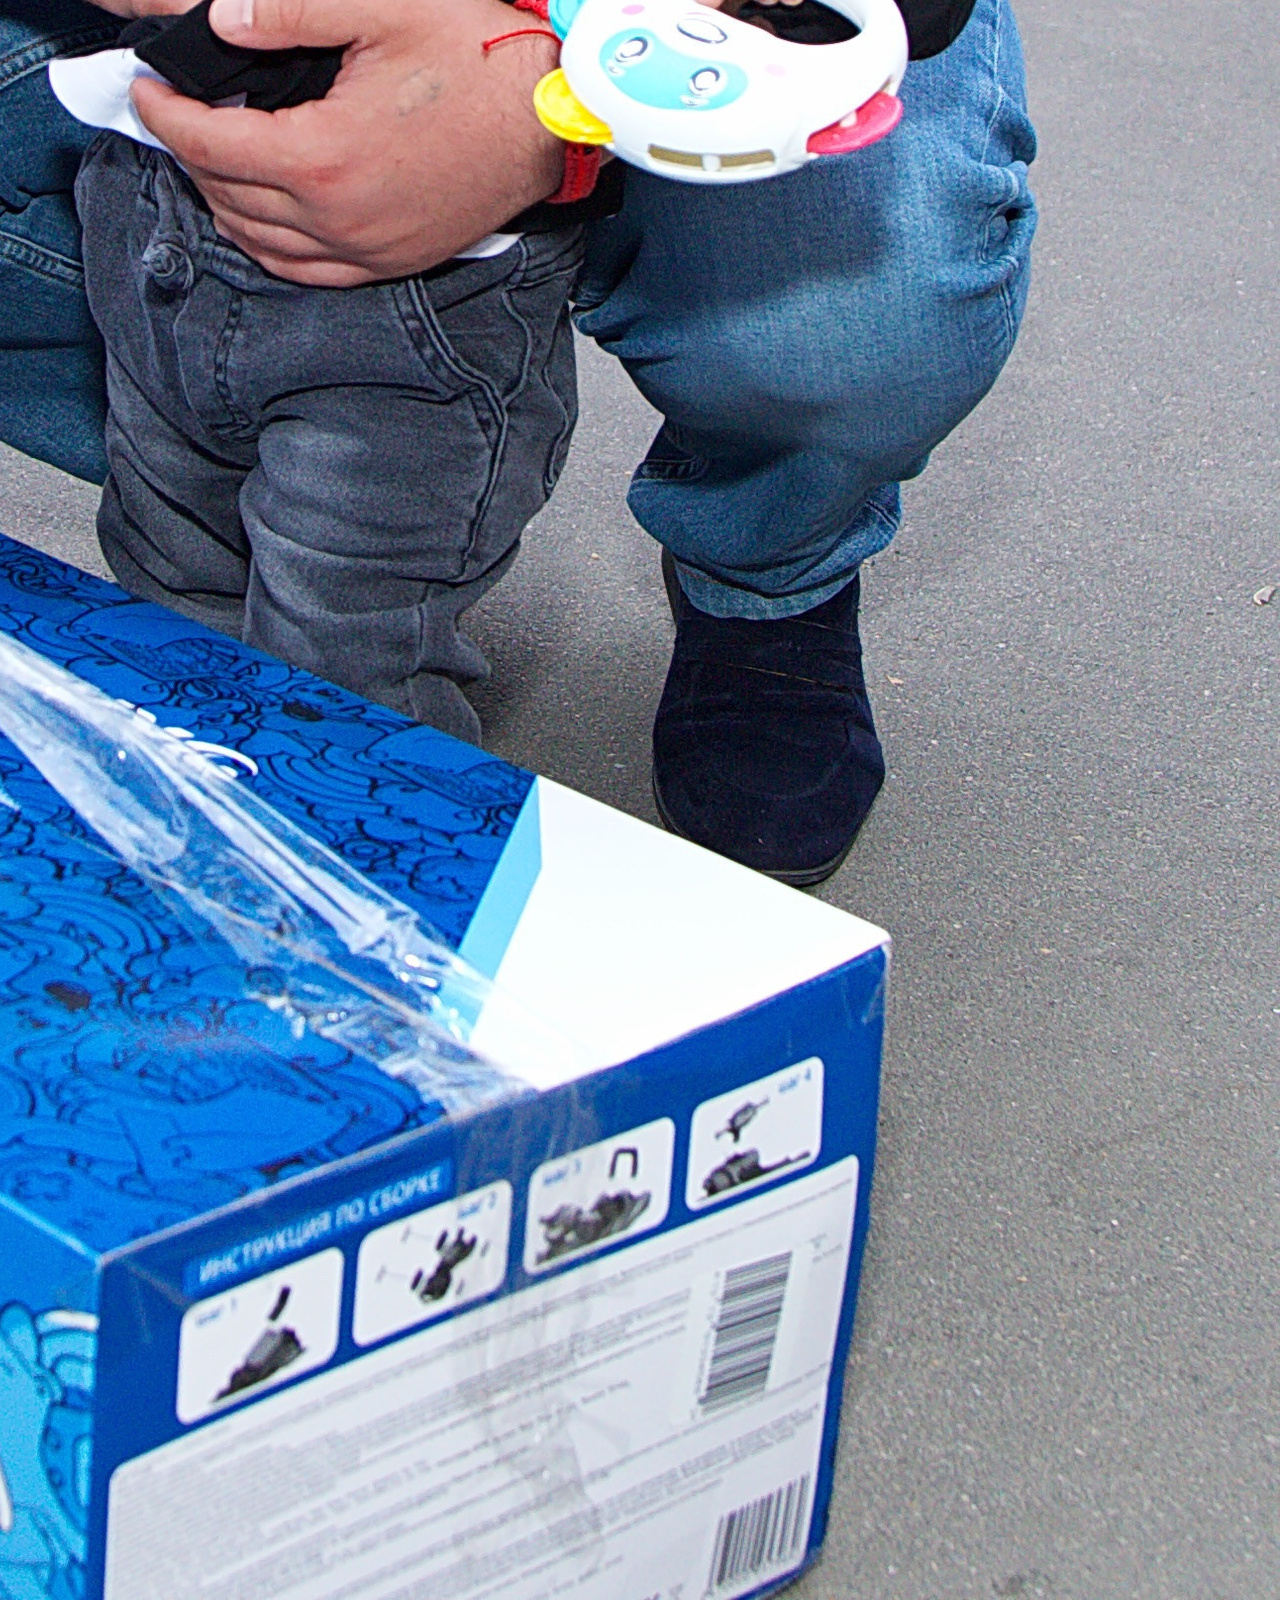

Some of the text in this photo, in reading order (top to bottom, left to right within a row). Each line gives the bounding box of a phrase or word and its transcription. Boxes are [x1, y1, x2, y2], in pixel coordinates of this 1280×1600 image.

[198, 1166, 442, 1284] ИНСТРУКЦИЯ ПО СБОРКЕ
